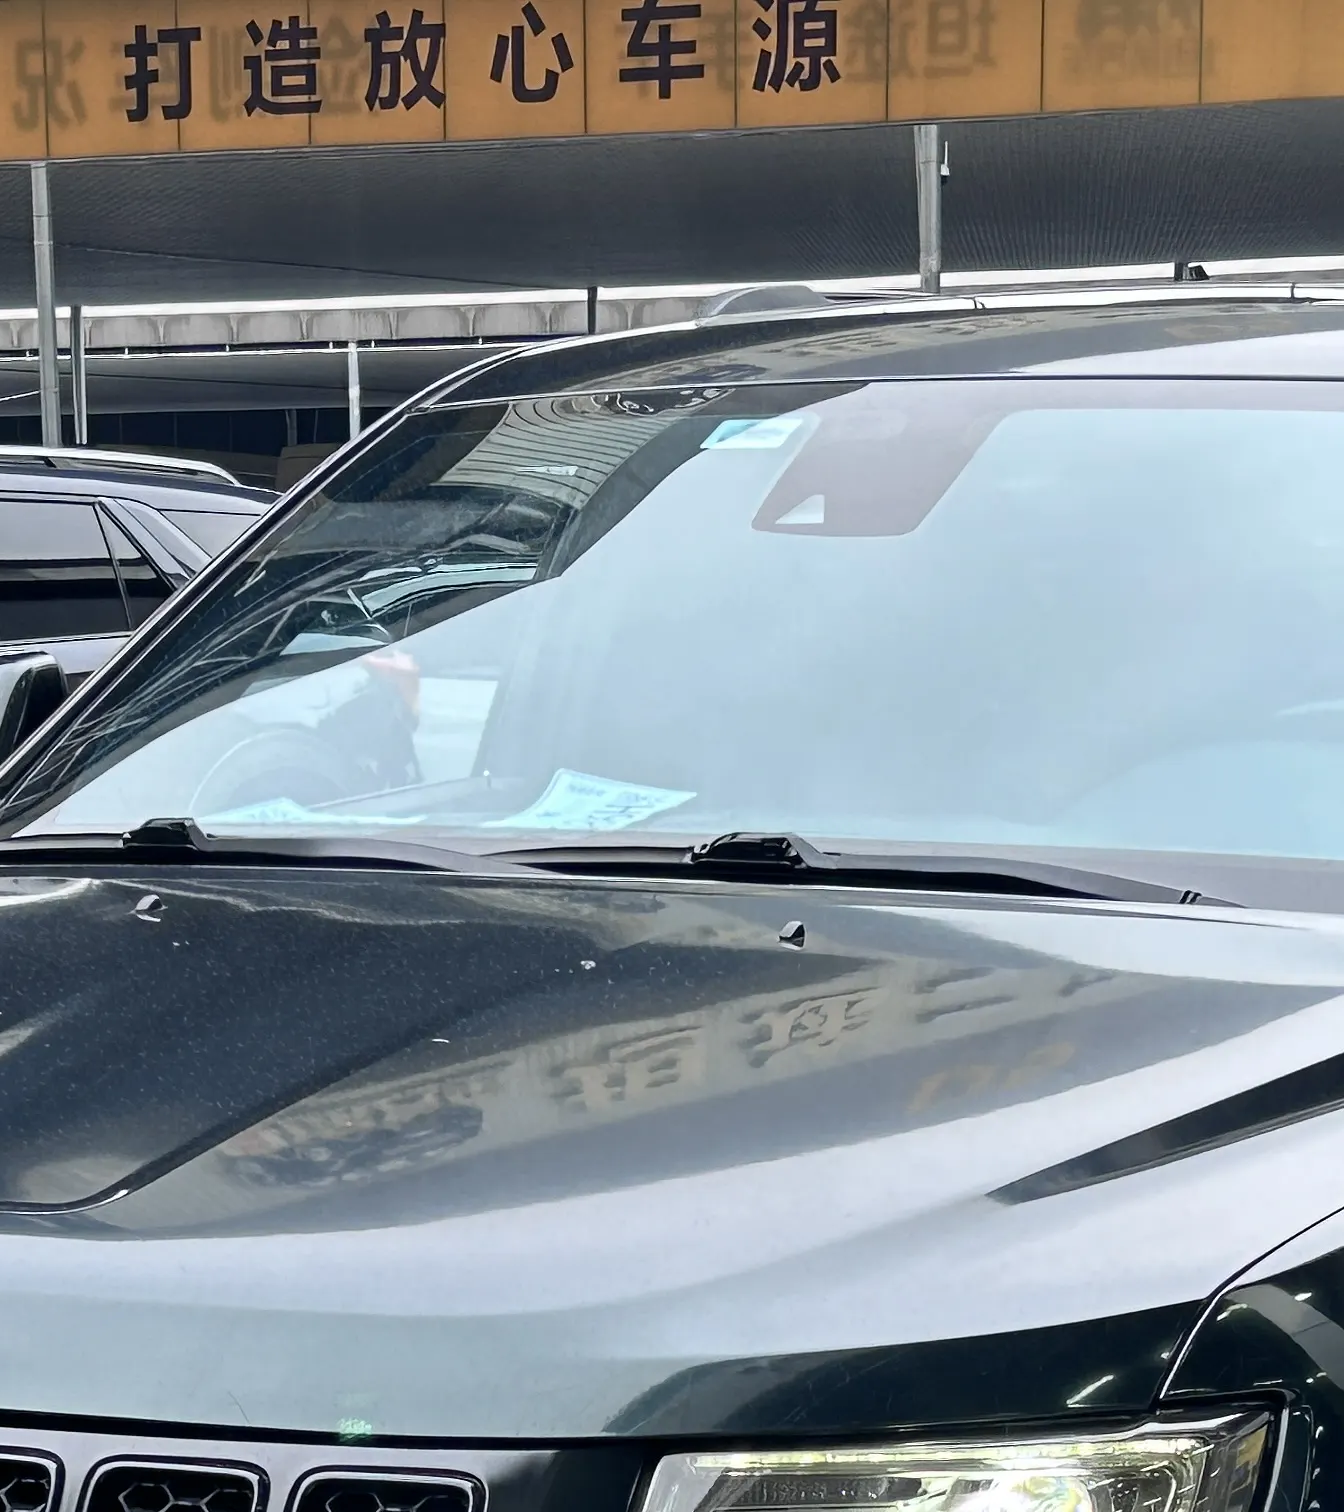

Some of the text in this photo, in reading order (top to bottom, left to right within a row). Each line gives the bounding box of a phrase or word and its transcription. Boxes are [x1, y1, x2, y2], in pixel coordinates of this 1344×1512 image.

[124, 0, 842, 122] 打造放心车源
